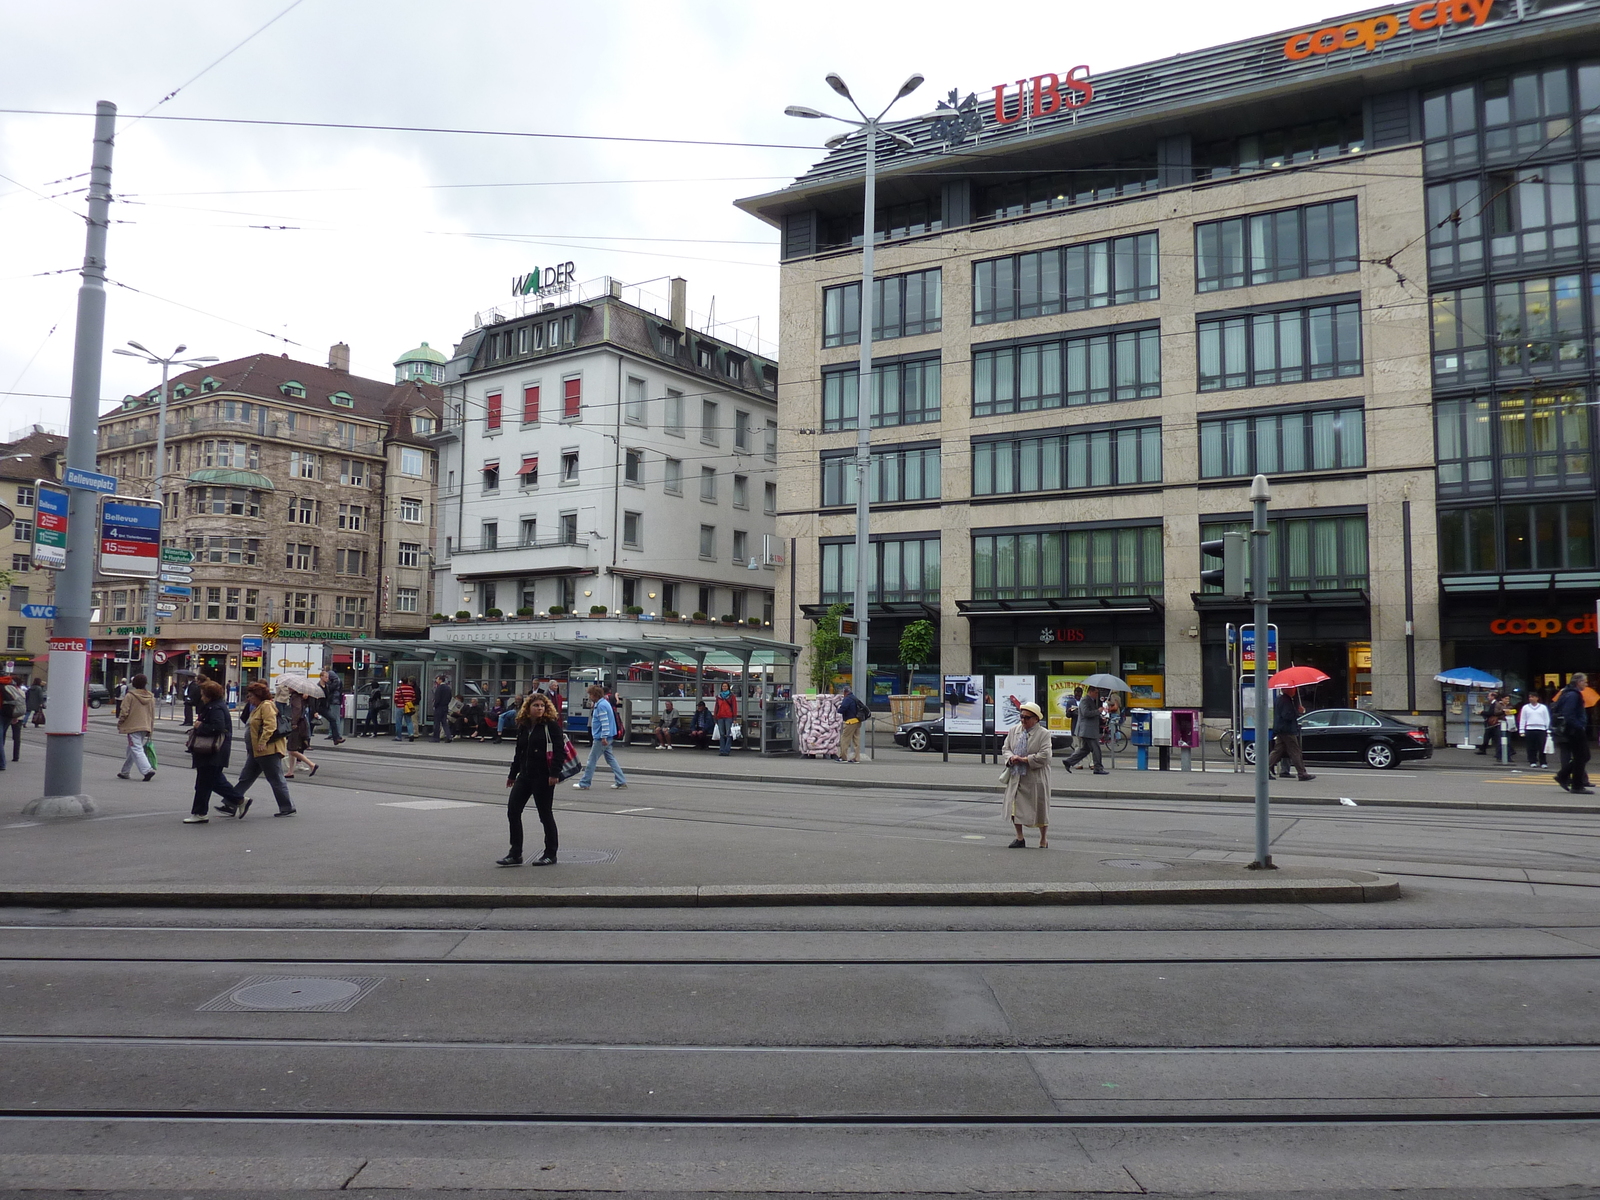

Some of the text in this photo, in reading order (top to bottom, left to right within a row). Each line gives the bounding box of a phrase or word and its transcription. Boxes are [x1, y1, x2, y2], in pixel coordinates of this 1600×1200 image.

[1283, 0, 1495, 62] coop city
[992, 64, 1094, 126] UBS
[512, 260, 576, 297] WALDER
[68, 472, 114, 491] Bellevueplatz
[39, 499, 58, 511] Bellevue
[41, 515, 47, 526] 2
[105, 512, 139, 523] Bellevue
[109, 528, 118, 538] 4
[104, 542, 118, 552] 15
[30, 606, 53, 618] WC
[278, 629, 351, 640] ODEON APOTHEKE
[1490, 619, 1561, 638] coop
[446, 631, 556, 641] VORDERER STERNEN
[1057, 629, 1084, 642] UBS
[196, 643, 229, 652] ODEON
